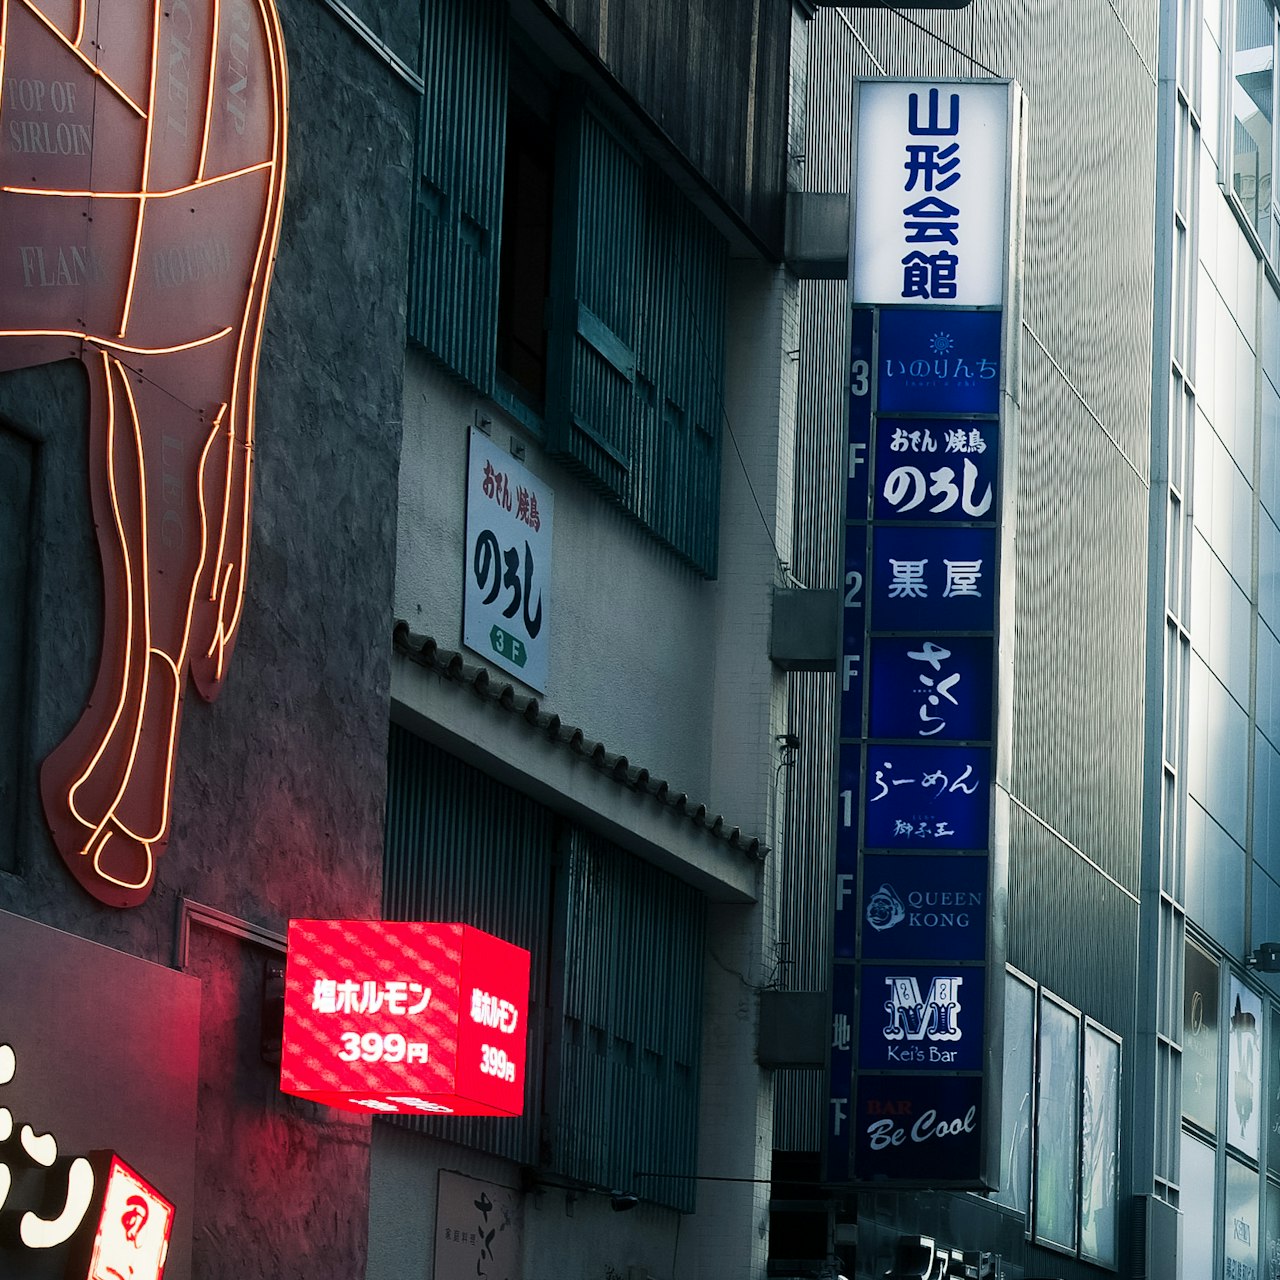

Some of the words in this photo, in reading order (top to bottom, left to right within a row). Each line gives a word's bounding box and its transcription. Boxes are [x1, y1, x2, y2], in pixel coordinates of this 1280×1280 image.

[6, 77, 46, 112] TOP
[51, 80, 77, 114] OF
[10, 119, 92, 156] SIRLOIN
[900, 87, 962, 300] 山形会館
[885, 358, 998, 380] いのりんち
[890, 427, 938, 453] おでん
[944, 427, 988, 454] 焼鳥
[480, 458, 514, 515] おでん
[514, 483, 542, 535] 焼鳥
[883, 457, 993, 518] のろし
[472, 527, 544, 640] のろし
[887, 557, 984, 600] 黒屋
[906, 641, 961, 737] さくら
[869, 761, 980, 803] らーめん
[907, 890, 983, 907] QUEEN
[908, 912, 970, 928] KONG
[311, 976, 433, 1017] 塩ホルモン
[336, 1030, 430, 1066] 399円
[478, 1043, 517, 1085] 399円
[886, 1045, 926, 1064] Kei's
[928, 1046, 958, 1064] Bar
[866, 1118, 908, 1152] Be
[910, 1103, 977, 1144] Cool
